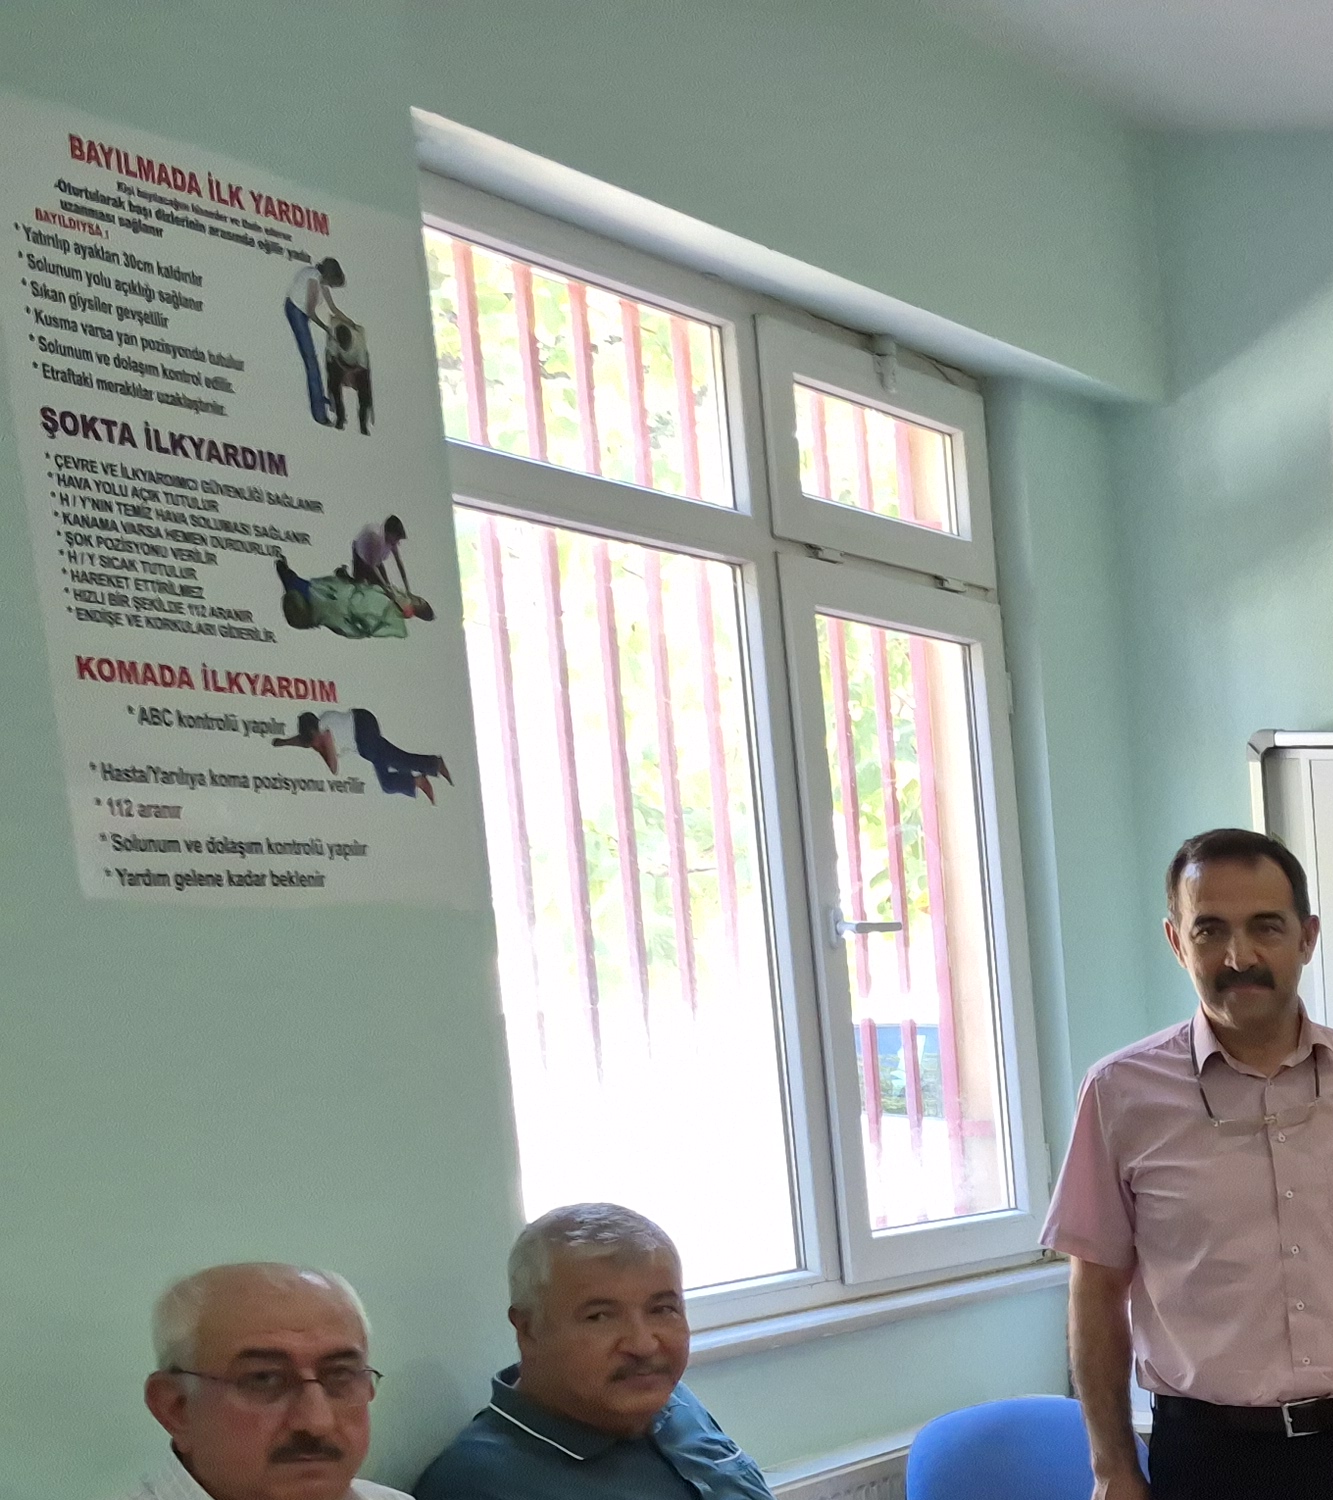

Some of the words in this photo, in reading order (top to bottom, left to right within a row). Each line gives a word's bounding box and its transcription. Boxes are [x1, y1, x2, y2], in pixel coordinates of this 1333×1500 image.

[69, 133, 202, 198] BAYILMADA
[207, 171, 246, 211] İLK
[249, 189, 330, 236] YARDIM
[26, 253, 83, 282] Solunum
[85, 270, 112, 289] yolu
[123, 252, 154, 275] 30cm
[69, 292, 113, 315] giysiler
[33, 308, 78, 333] Kusma
[80, 322, 114, 342] varsa
[38, 335, 94, 362] Solunum
[95, 352, 111, 367] ve
[114, 353, 159, 379] dolaşım
[42, 362, 93, 388] Etraftaki
[39, 405, 138, 449] ŞOKTA
[144, 420, 288, 477] İLKYARDIM
[54, 453, 99, 475] ÇEVRE
[101, 461, 119, 477] VE
[56, 473, 92, 491] HAVA
[93, 479, 129, 497] YOLU
[62, 512, 120, 532] KANAMA
[65, 531, 94, 548] ŞOK
[70, 569, 131, 589] HAREKET
[75, 655, 196, 691] KOMADA
[201, 662, 338, 703] İLKYARDIM
[138, 705, 174, 728] ABC
[209, 769, 250, 789] koma
[106, 797, 134, 817] 112
[183, 839, 203, 853] ve
[174, 869, 224, 891] gelene
[226, 869, 267, 887] kadar
